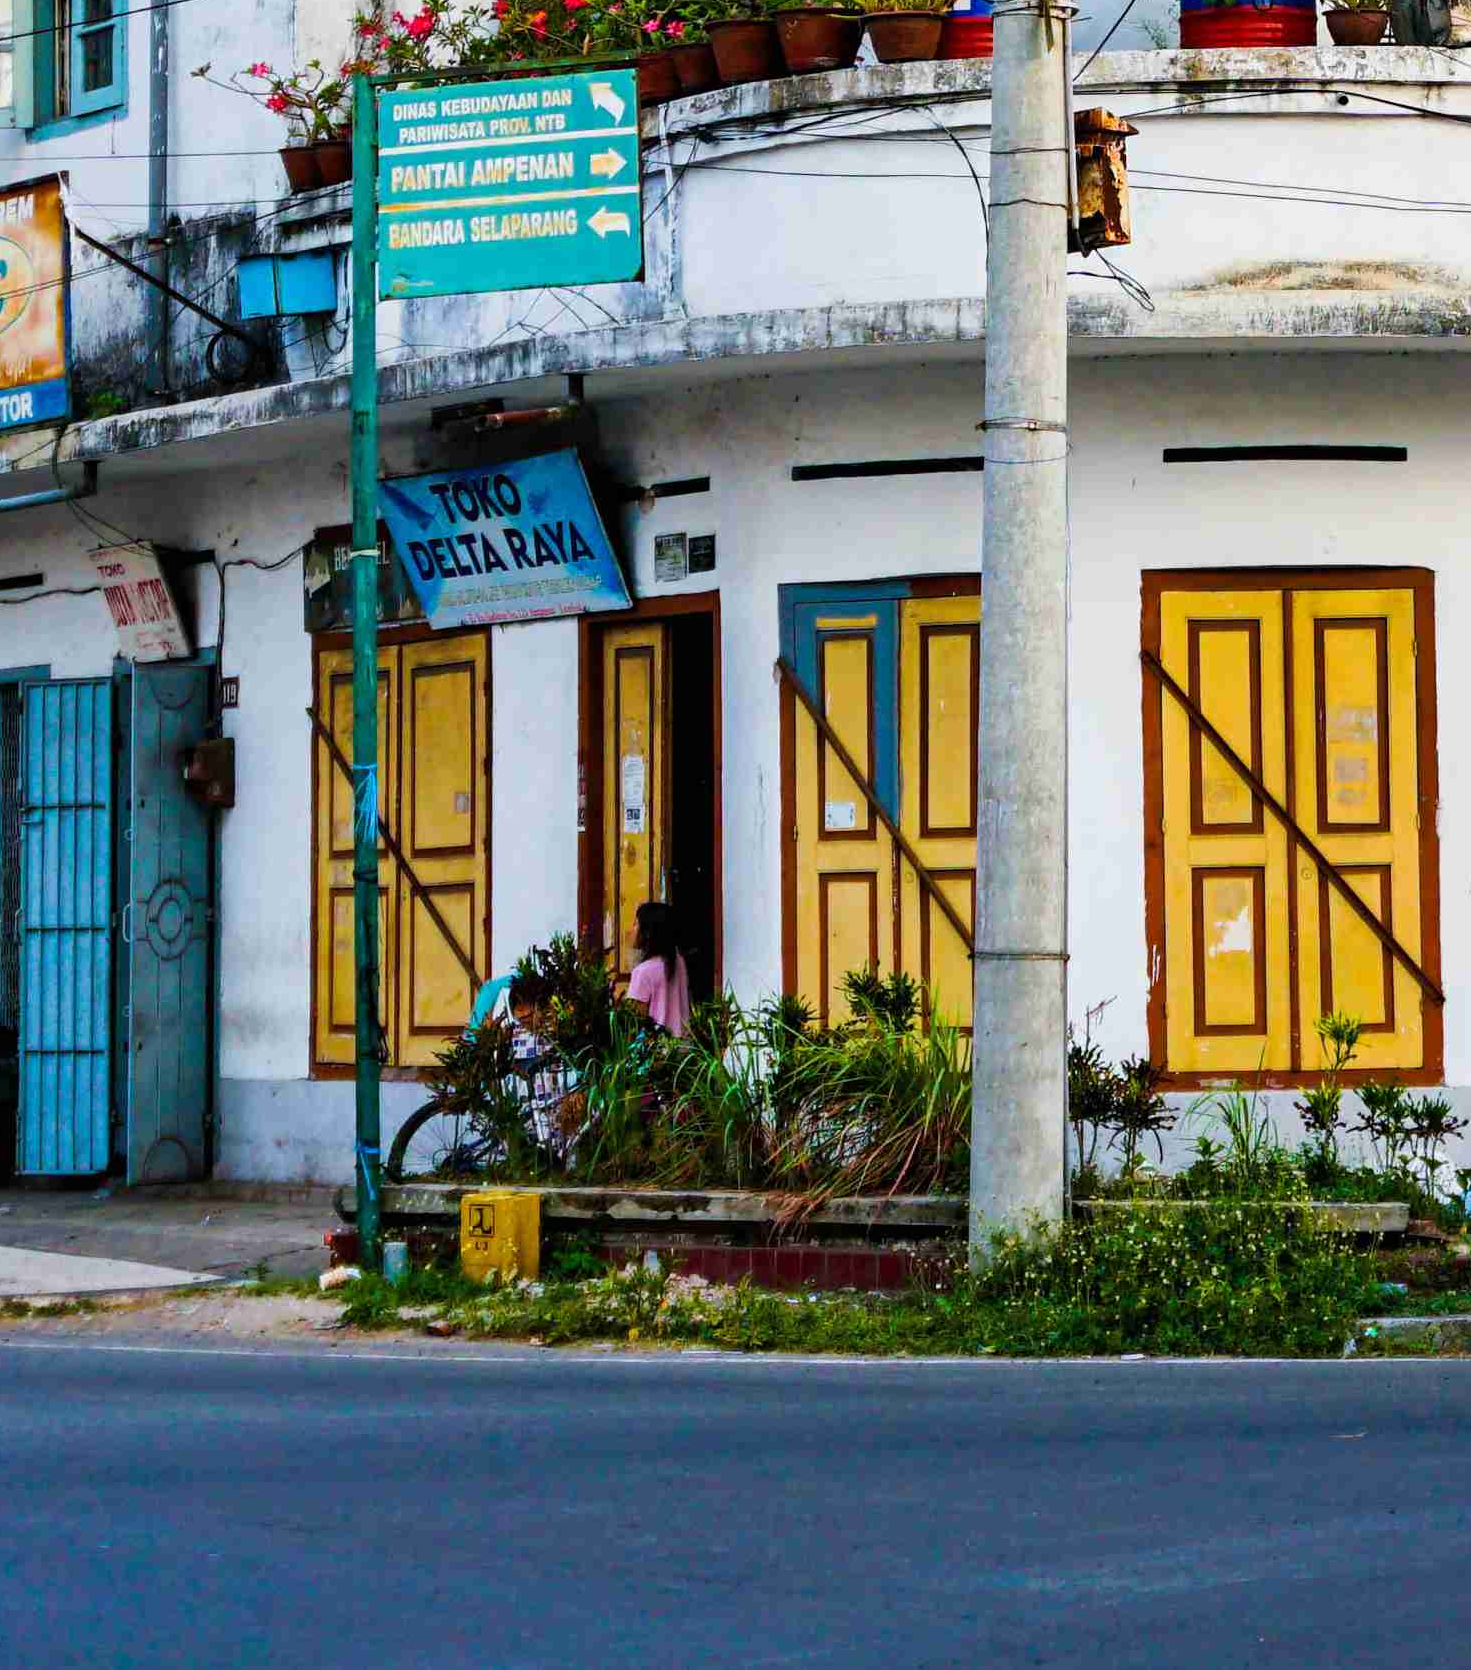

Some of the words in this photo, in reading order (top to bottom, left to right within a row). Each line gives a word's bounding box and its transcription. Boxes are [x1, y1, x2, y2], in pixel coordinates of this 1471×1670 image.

[393, 101, 436, 121] DINAS
[441, 92, 537, 117] KEBUDAYAAN
[542, 89, 572, 108] DAN
[399, 121, 485, 145] PARIWISATA
[490, 117, 532, 137] PROV.
[535, 114, 566, 131] NTB
[391, 161, 465, 193] PANTAI
[471, 152, 574, 186] AMPENAN
[389, 219, 466, 249] BANDARA
[470, 209, 577, 242] SELAPARANG
[429, 473, 522, 524] TOKO
[97, 563, 126, 577] TOKO
[407, 533, 507, 581] DELTA
[505, 521, 595, 570] RAYA
